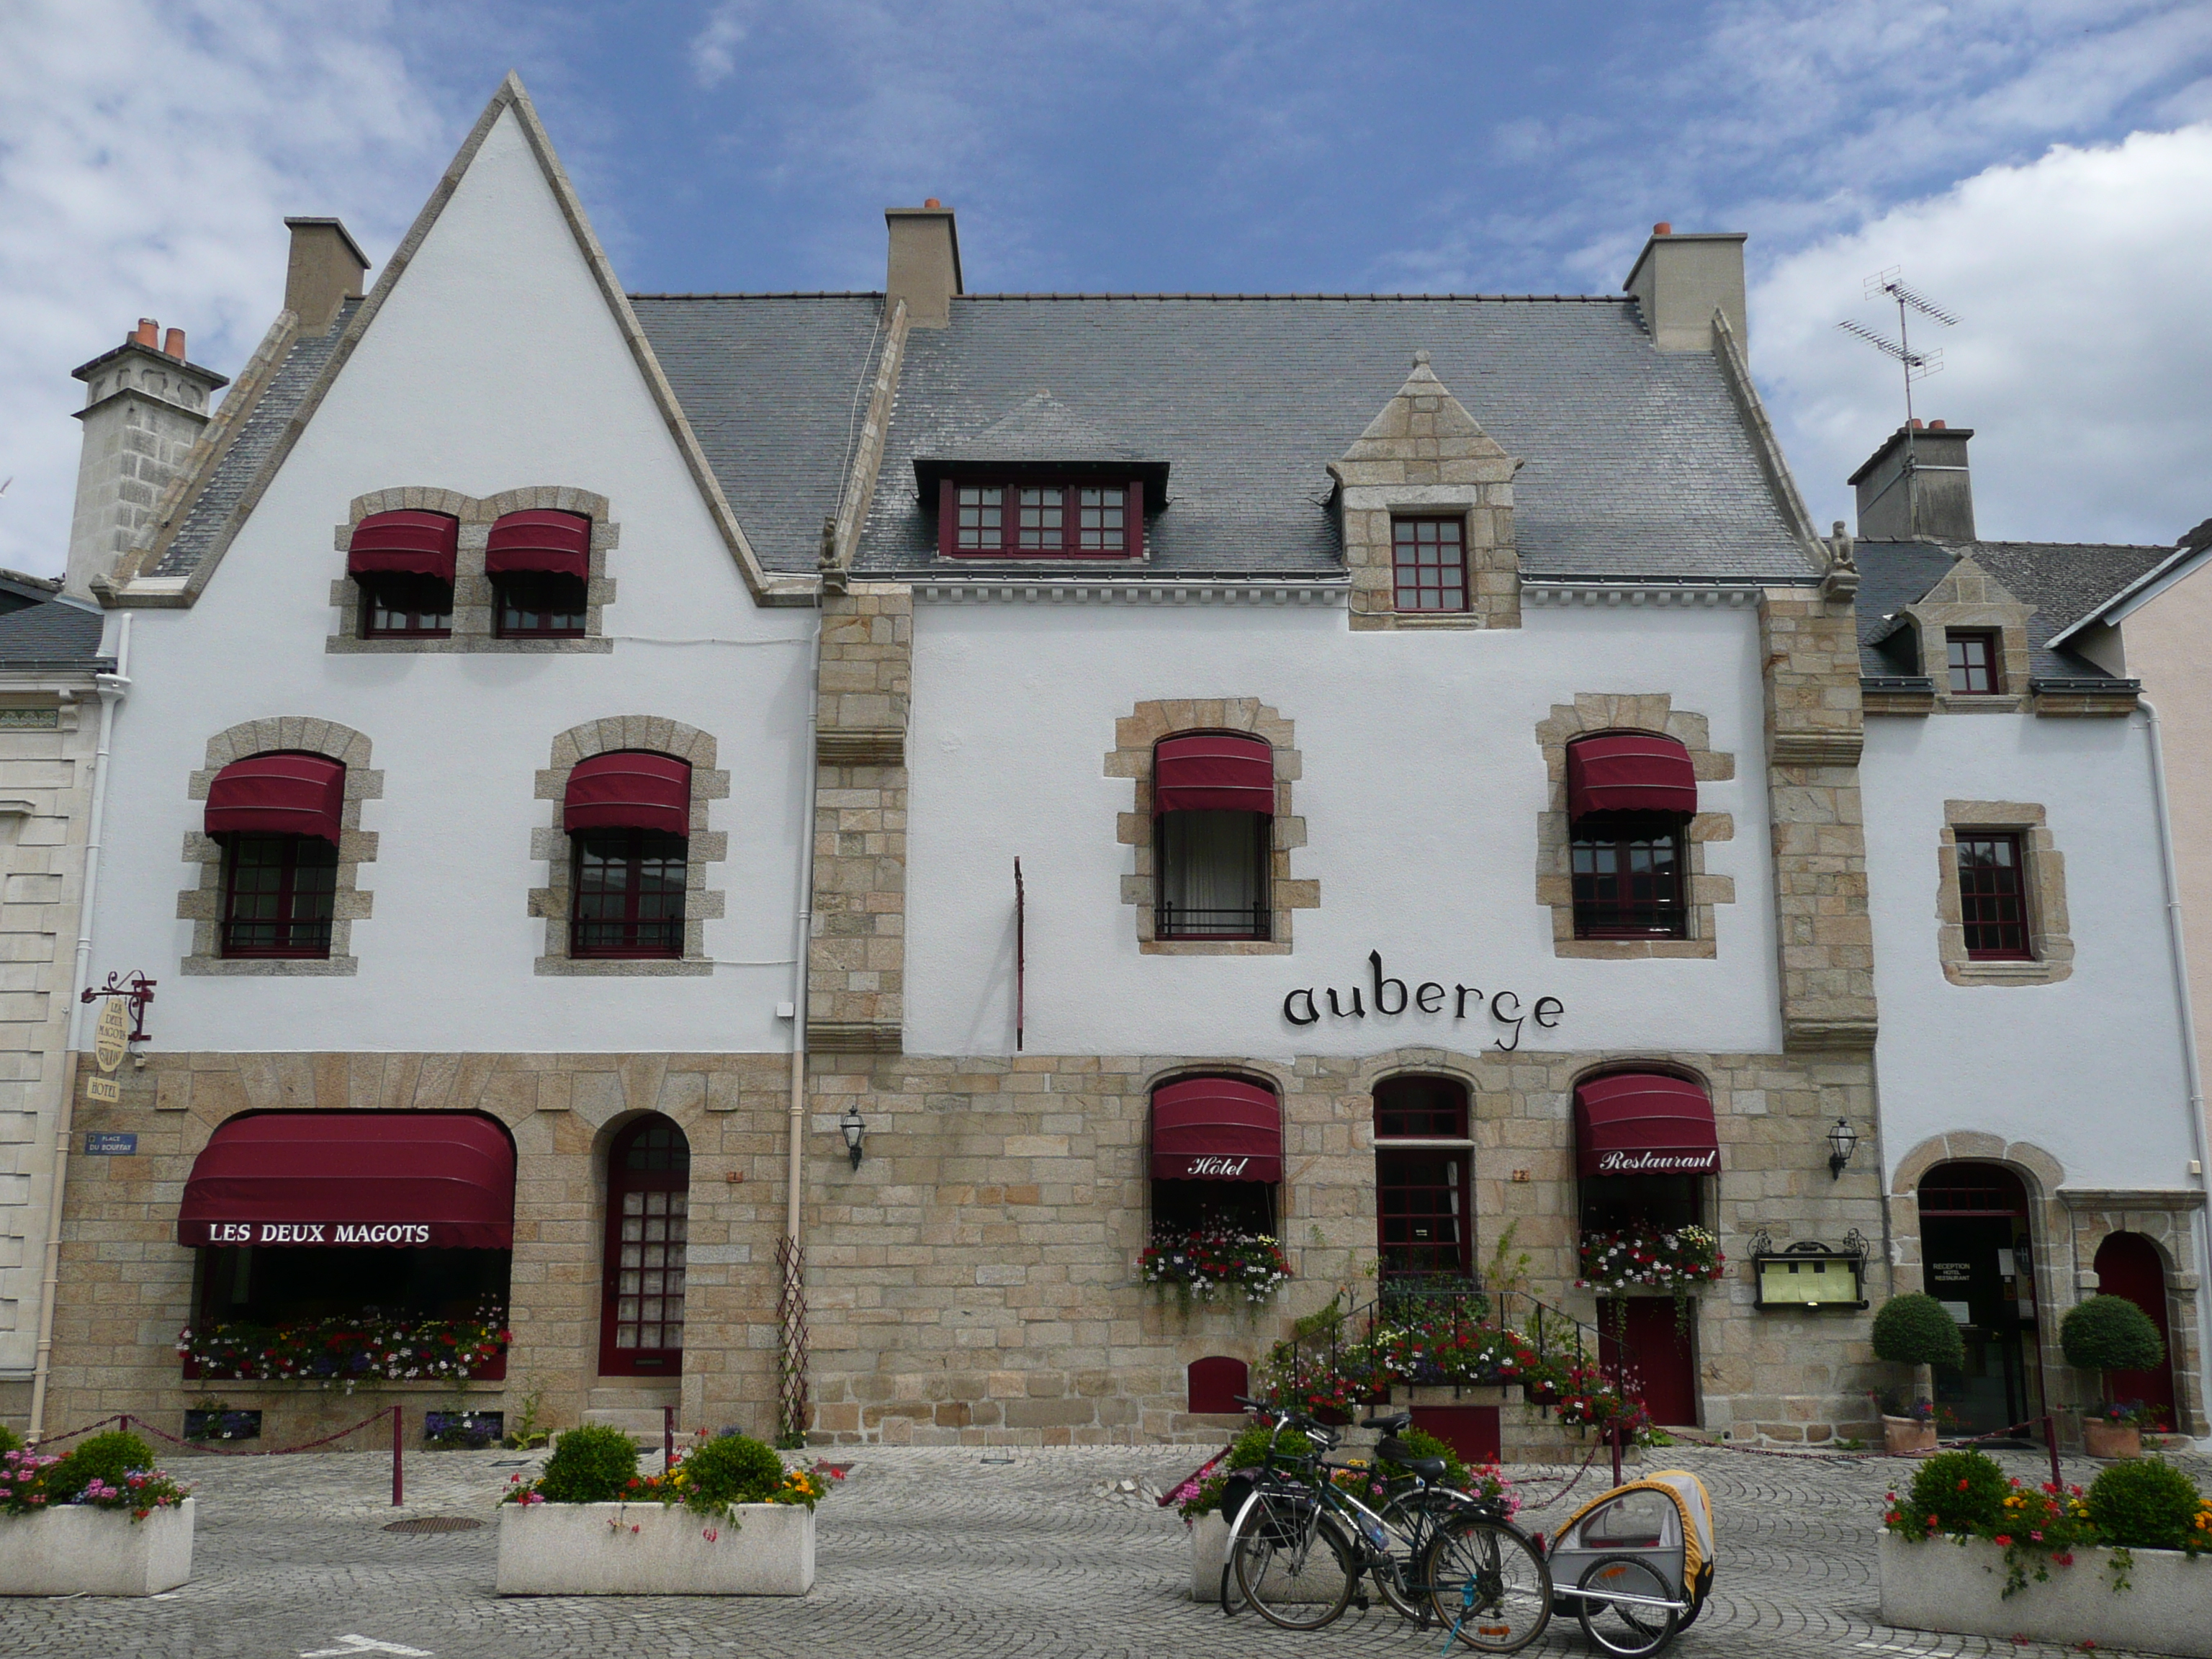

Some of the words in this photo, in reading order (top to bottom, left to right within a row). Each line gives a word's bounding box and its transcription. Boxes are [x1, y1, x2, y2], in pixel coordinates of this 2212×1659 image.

[110, 1002, 122, 1014] LES
[1283, 949, 1565, 1051] auberge
[105, 1014, 123, 1027] DEUX
[98, 1025, 126, 1040] MAGOTS
[91, 1082, 117, 1098] HOTEL
[1187, 1156, 1249, 1175] Hôtel
[1599, 1151, 1716, 1170] Restaurant
[1519, 1170, 1525, 1179] 2
[210, 1224, 251, 1241] LES
[260, 1224, 325, 1242] DEUX
[334, 1225, 429, 1243] MAGOTS
